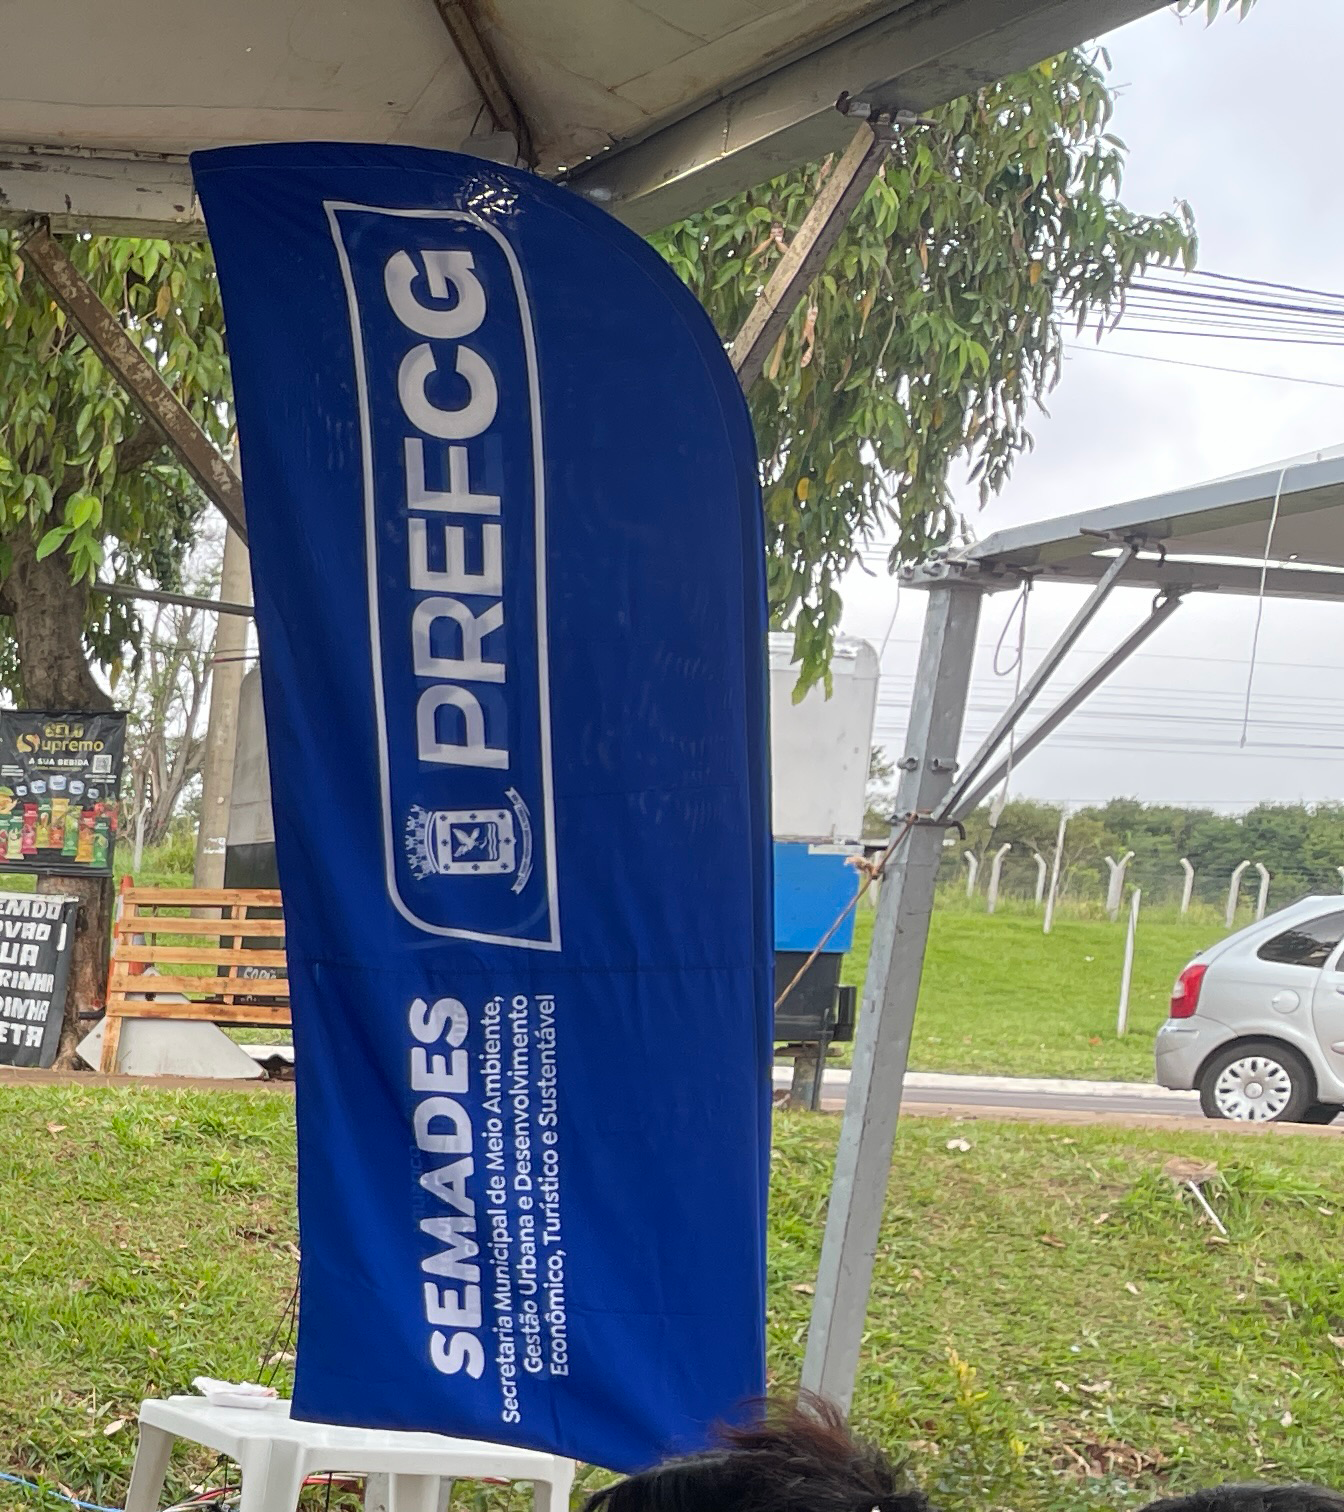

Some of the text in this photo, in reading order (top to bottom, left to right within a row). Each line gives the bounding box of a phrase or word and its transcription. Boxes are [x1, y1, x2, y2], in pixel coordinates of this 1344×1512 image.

[384, 249, 510, 770] PREFCG
[28, 757, 35, 765] A
[57, 758, 89, 766] BEBIDA
[409, 997, 485, 1380] SEMADES
[478, 995, 521, 1424] Secretaria Municipal de Meio Ambiente,
[506, 994, 544, 1374] Gestão Urbana e Desenvolvimento
[534, 994, 570, 1377] Econômico, Turístico e Sustentável
